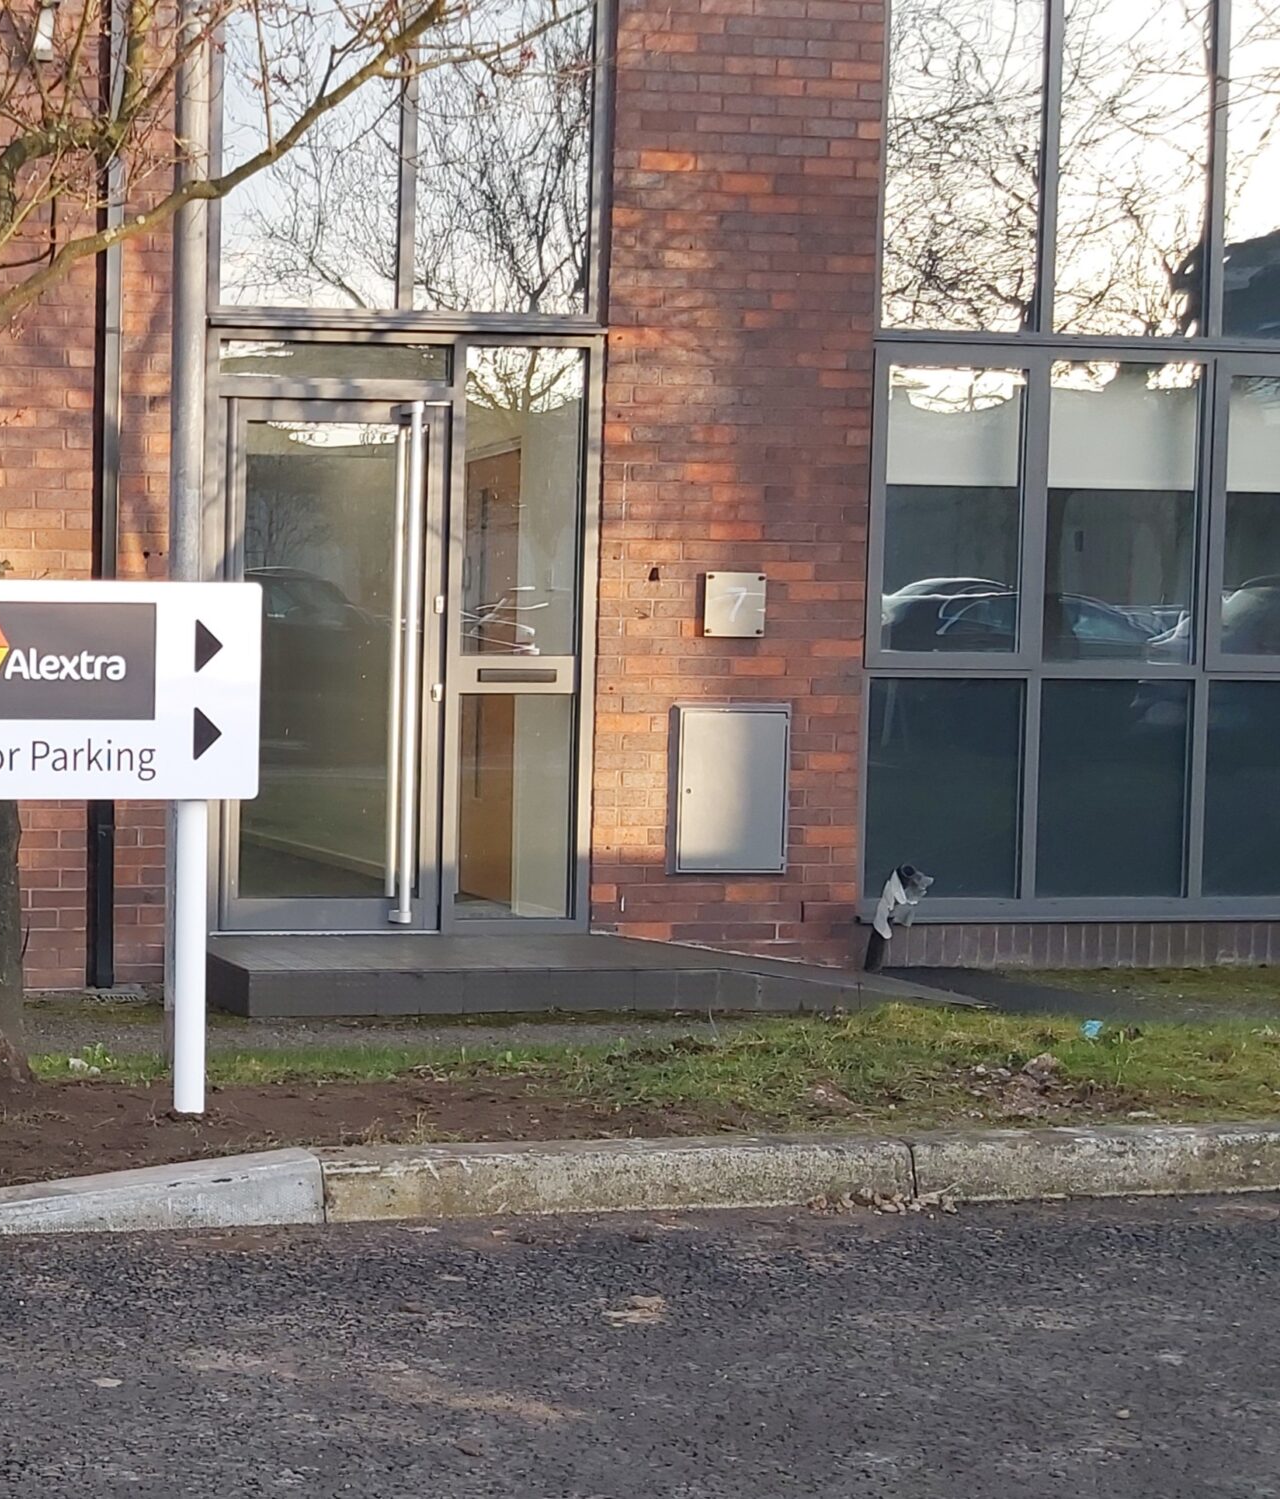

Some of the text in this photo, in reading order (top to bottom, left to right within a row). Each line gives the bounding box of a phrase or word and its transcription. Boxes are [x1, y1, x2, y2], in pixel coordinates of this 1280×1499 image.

[726, 587, 747, 623] 7
[4, 648, 127, 681] Alextra
[31, 738, 157, 781] Parking
